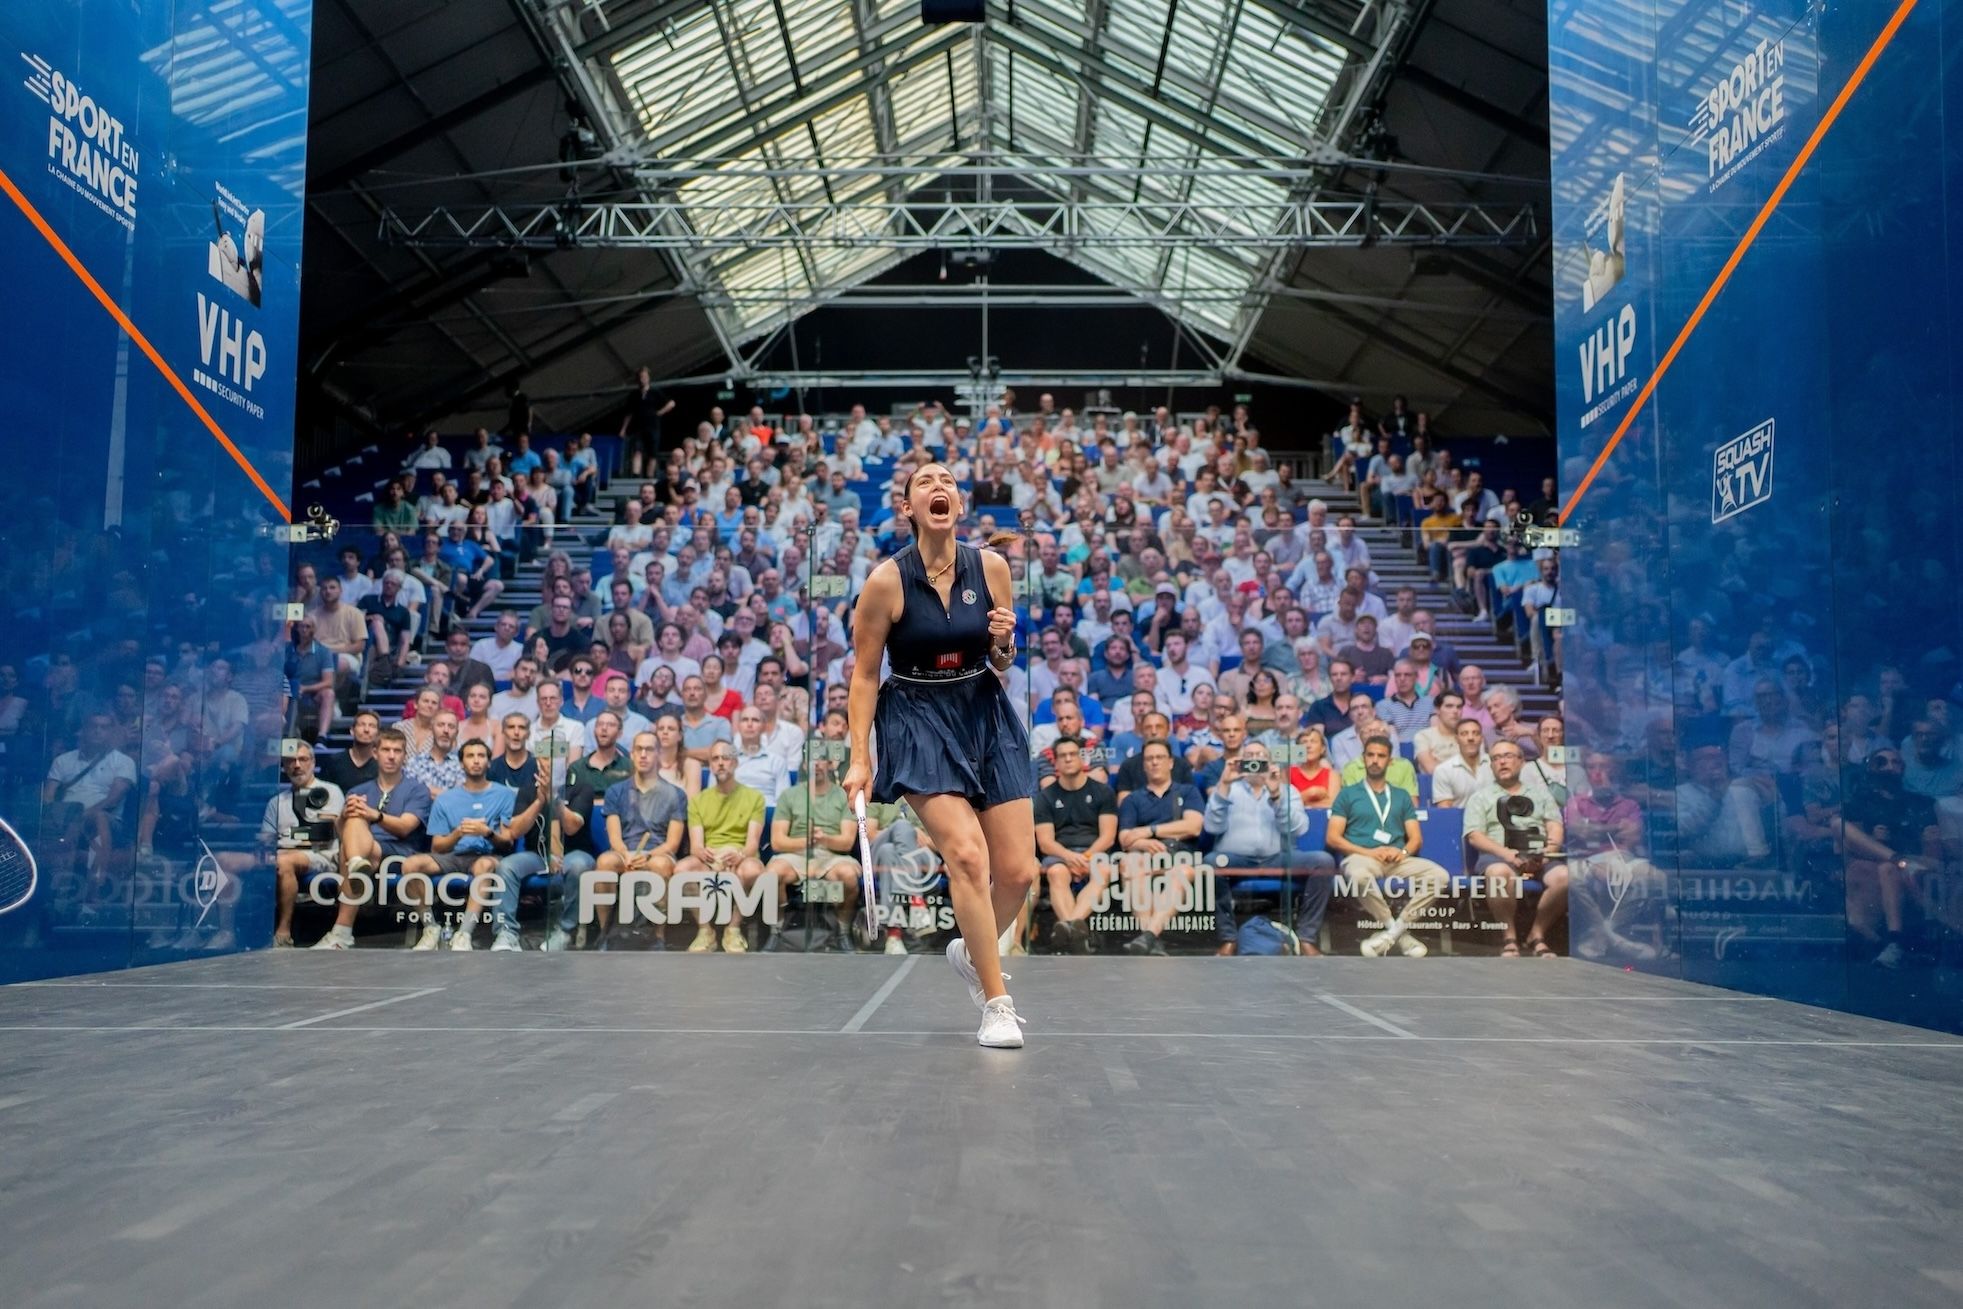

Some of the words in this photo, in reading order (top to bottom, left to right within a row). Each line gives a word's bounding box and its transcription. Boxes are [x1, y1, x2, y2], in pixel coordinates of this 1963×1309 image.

[1708, 38, 1767, 130] SPORT
[1766, 40, 1784, 78] EN
[51, 70, 124, 160] SPORT
[121, 141, 139, 174] EN
[1708, 75, 1784, 178] FRANCE
[48, 116, 138, 218] FRANCE
[47, 163, 56, 175] LA
[76, 183, 85, 196] DU
[84, 189, 116, 218] MOUVEMENT
[115, 211, 136, 232] SPORTIF
[197, 291, 267, 392] VHP
[1579, 303, 1637, 405] VHP
[217, 383, 247, 409] SECURITY
[245, 399, 264, 420] PAPER
[1717, 424, 1771, 475] SQUASH
[1735, 451, 1770, 505] TV
[308, 854, 507, 907] coface
[578, 870, 779, 926] FRAM
[887, 895, 923, 905] VILLE
[927, 895, 944, 905] DE
[1333, 874, 1530, 900] MACHEFERT
[396, 911, 433, 924] FOR
[443, 911, 506, 924] TRADE
[875, 904, 956, 931] PARIS
[1409, 906, 1456, 918] GROUP
[1452, 920, 1471, 930] Bars
[1480, 920, 1509, 931] Events
